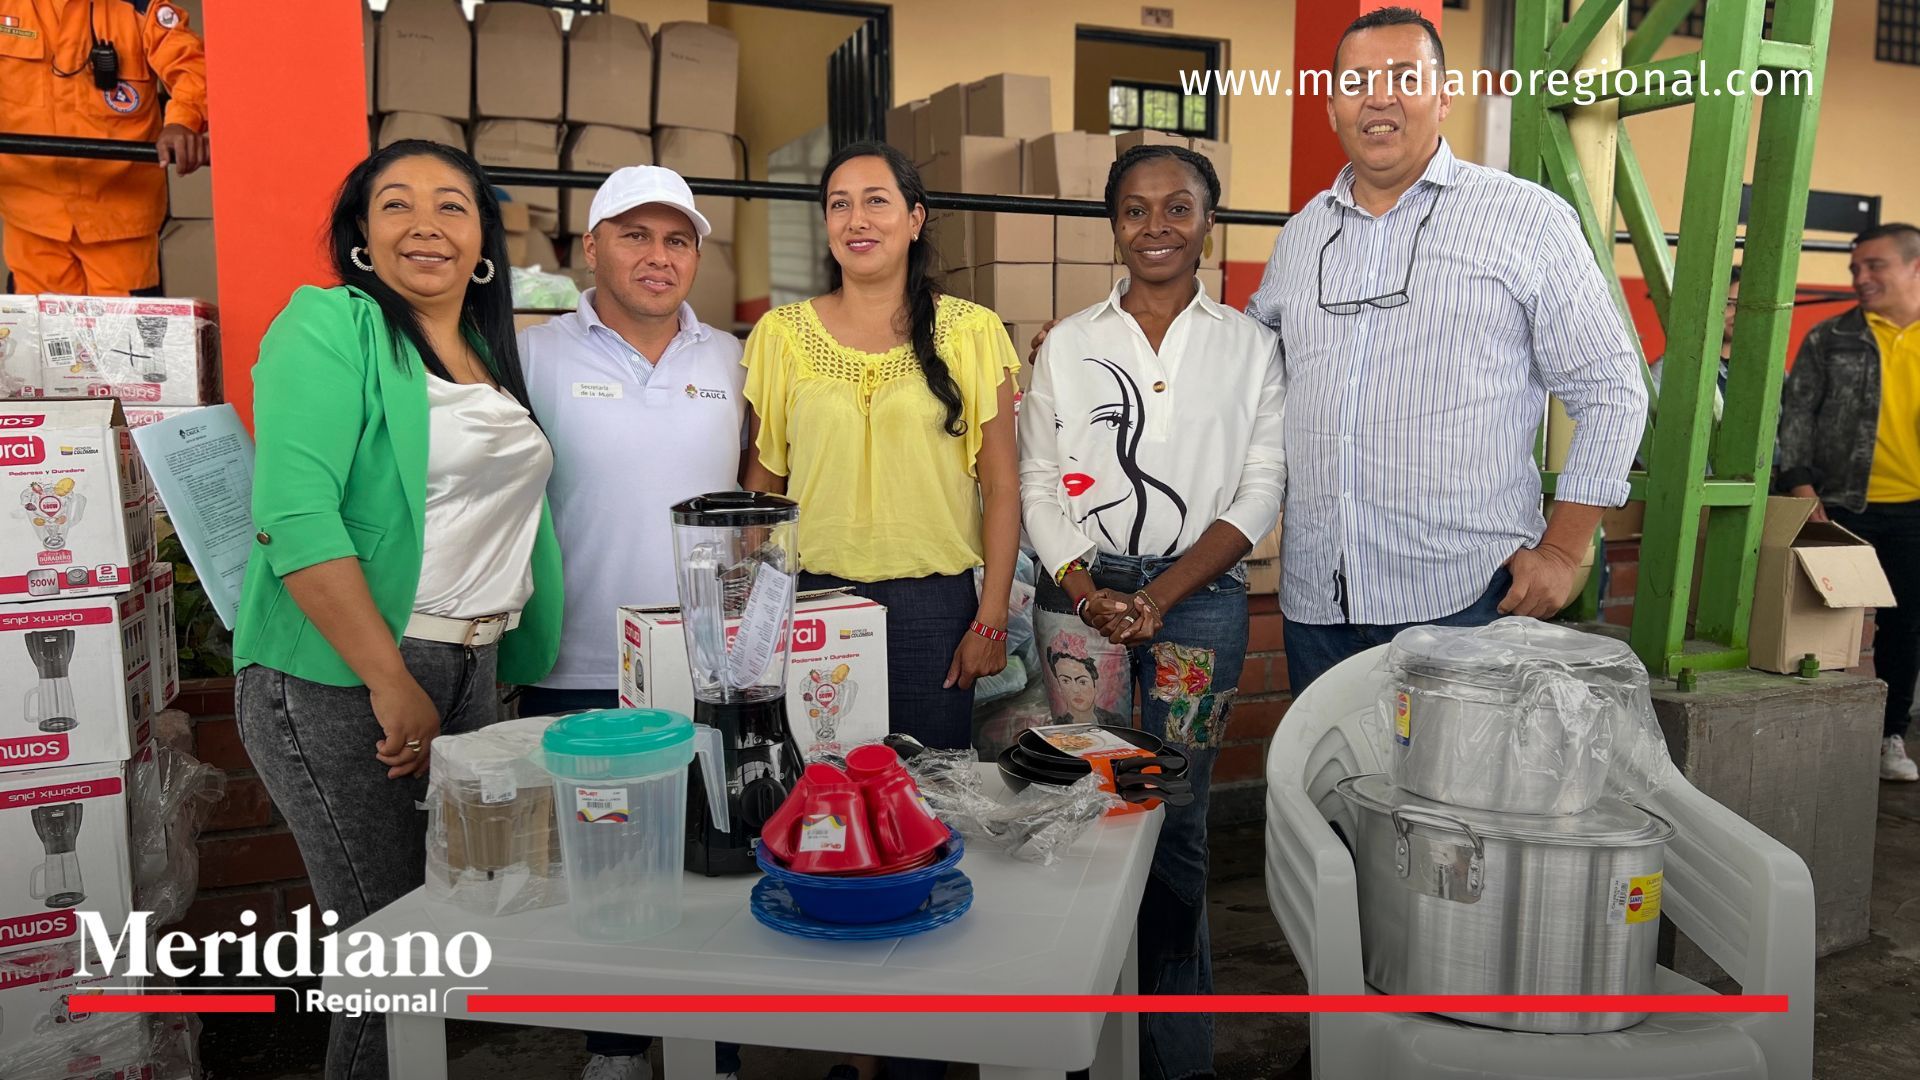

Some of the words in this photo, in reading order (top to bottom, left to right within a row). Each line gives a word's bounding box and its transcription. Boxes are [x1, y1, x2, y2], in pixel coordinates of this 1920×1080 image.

[700, 391, 727, 400] CAUCA
[100, 566, 113, 575] 2
[30, 578, 56, 588] 500W
[2, 615, 29, 624] plus
[33, 612, 84, 623] Optimix
[9, 791, 36, 802] plus
[40, 785, 92, 799] Optimix
